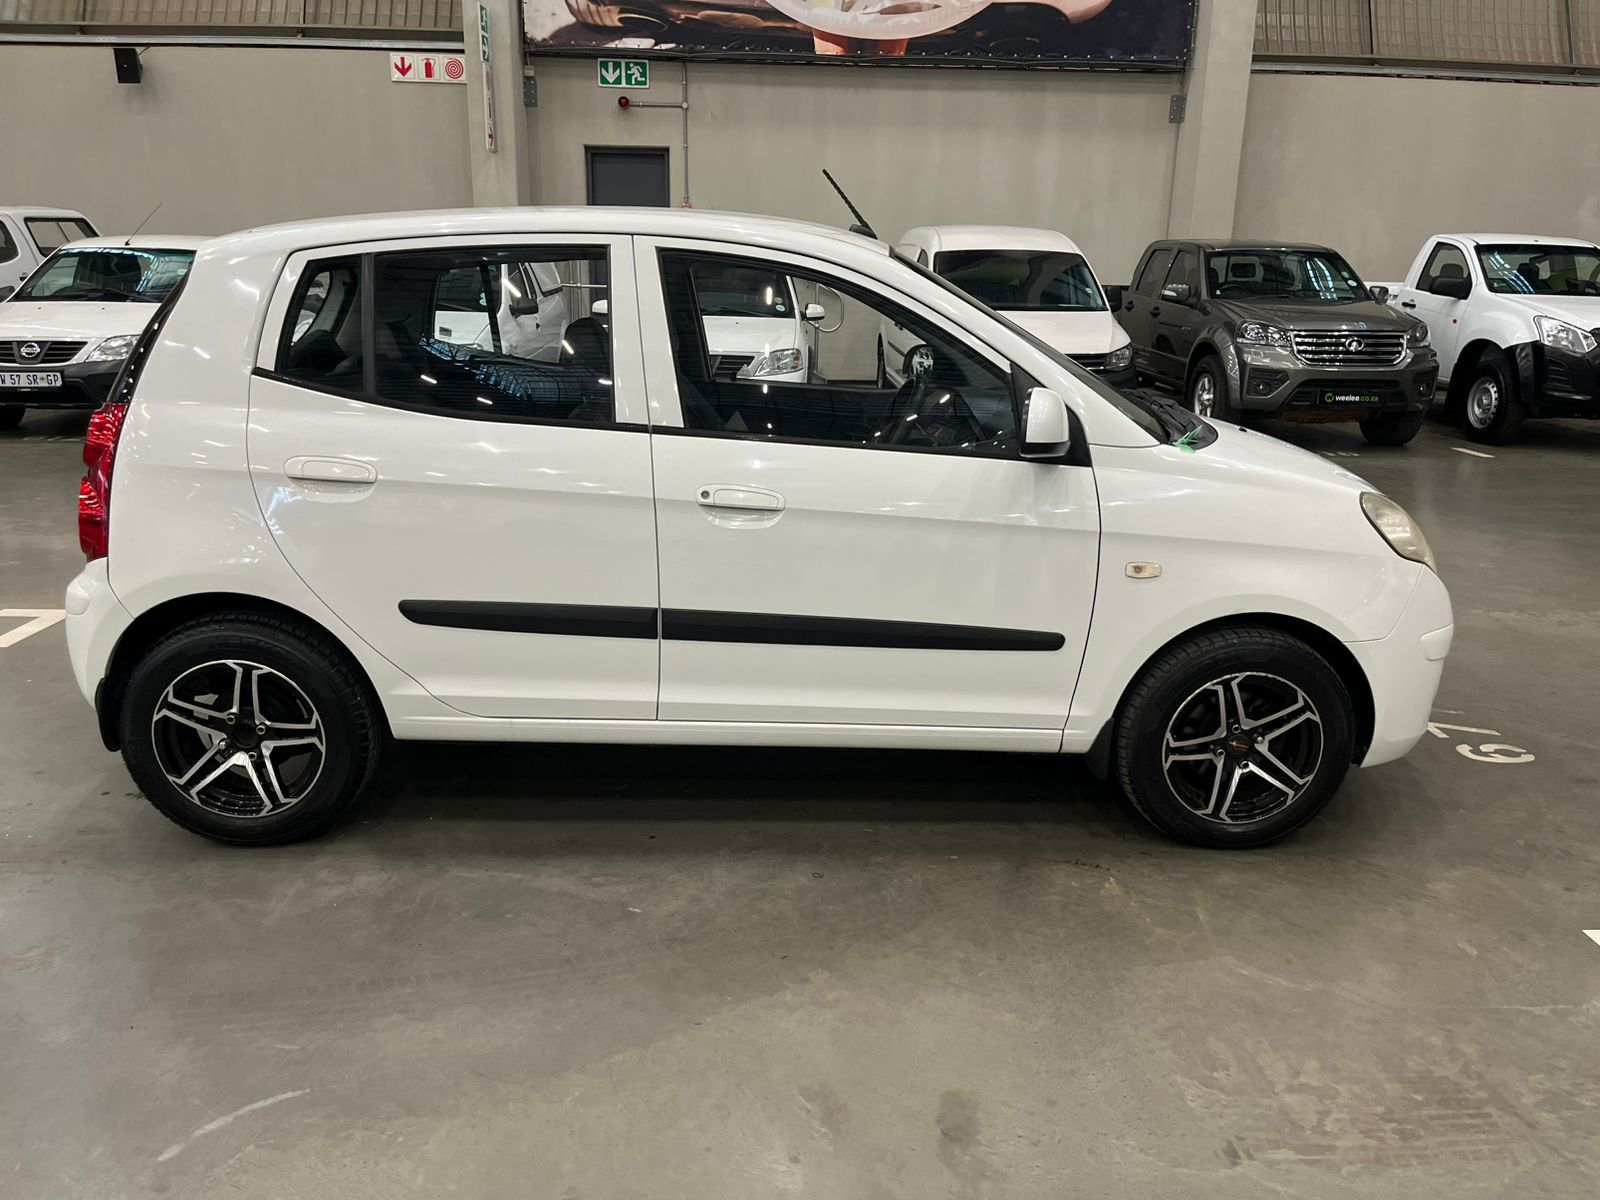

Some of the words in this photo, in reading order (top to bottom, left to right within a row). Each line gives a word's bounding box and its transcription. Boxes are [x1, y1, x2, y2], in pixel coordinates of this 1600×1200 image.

[10, 374, 21, 385] 57
[26, 374, 39, 385] SR
[46, 374, 59, 385] GP
